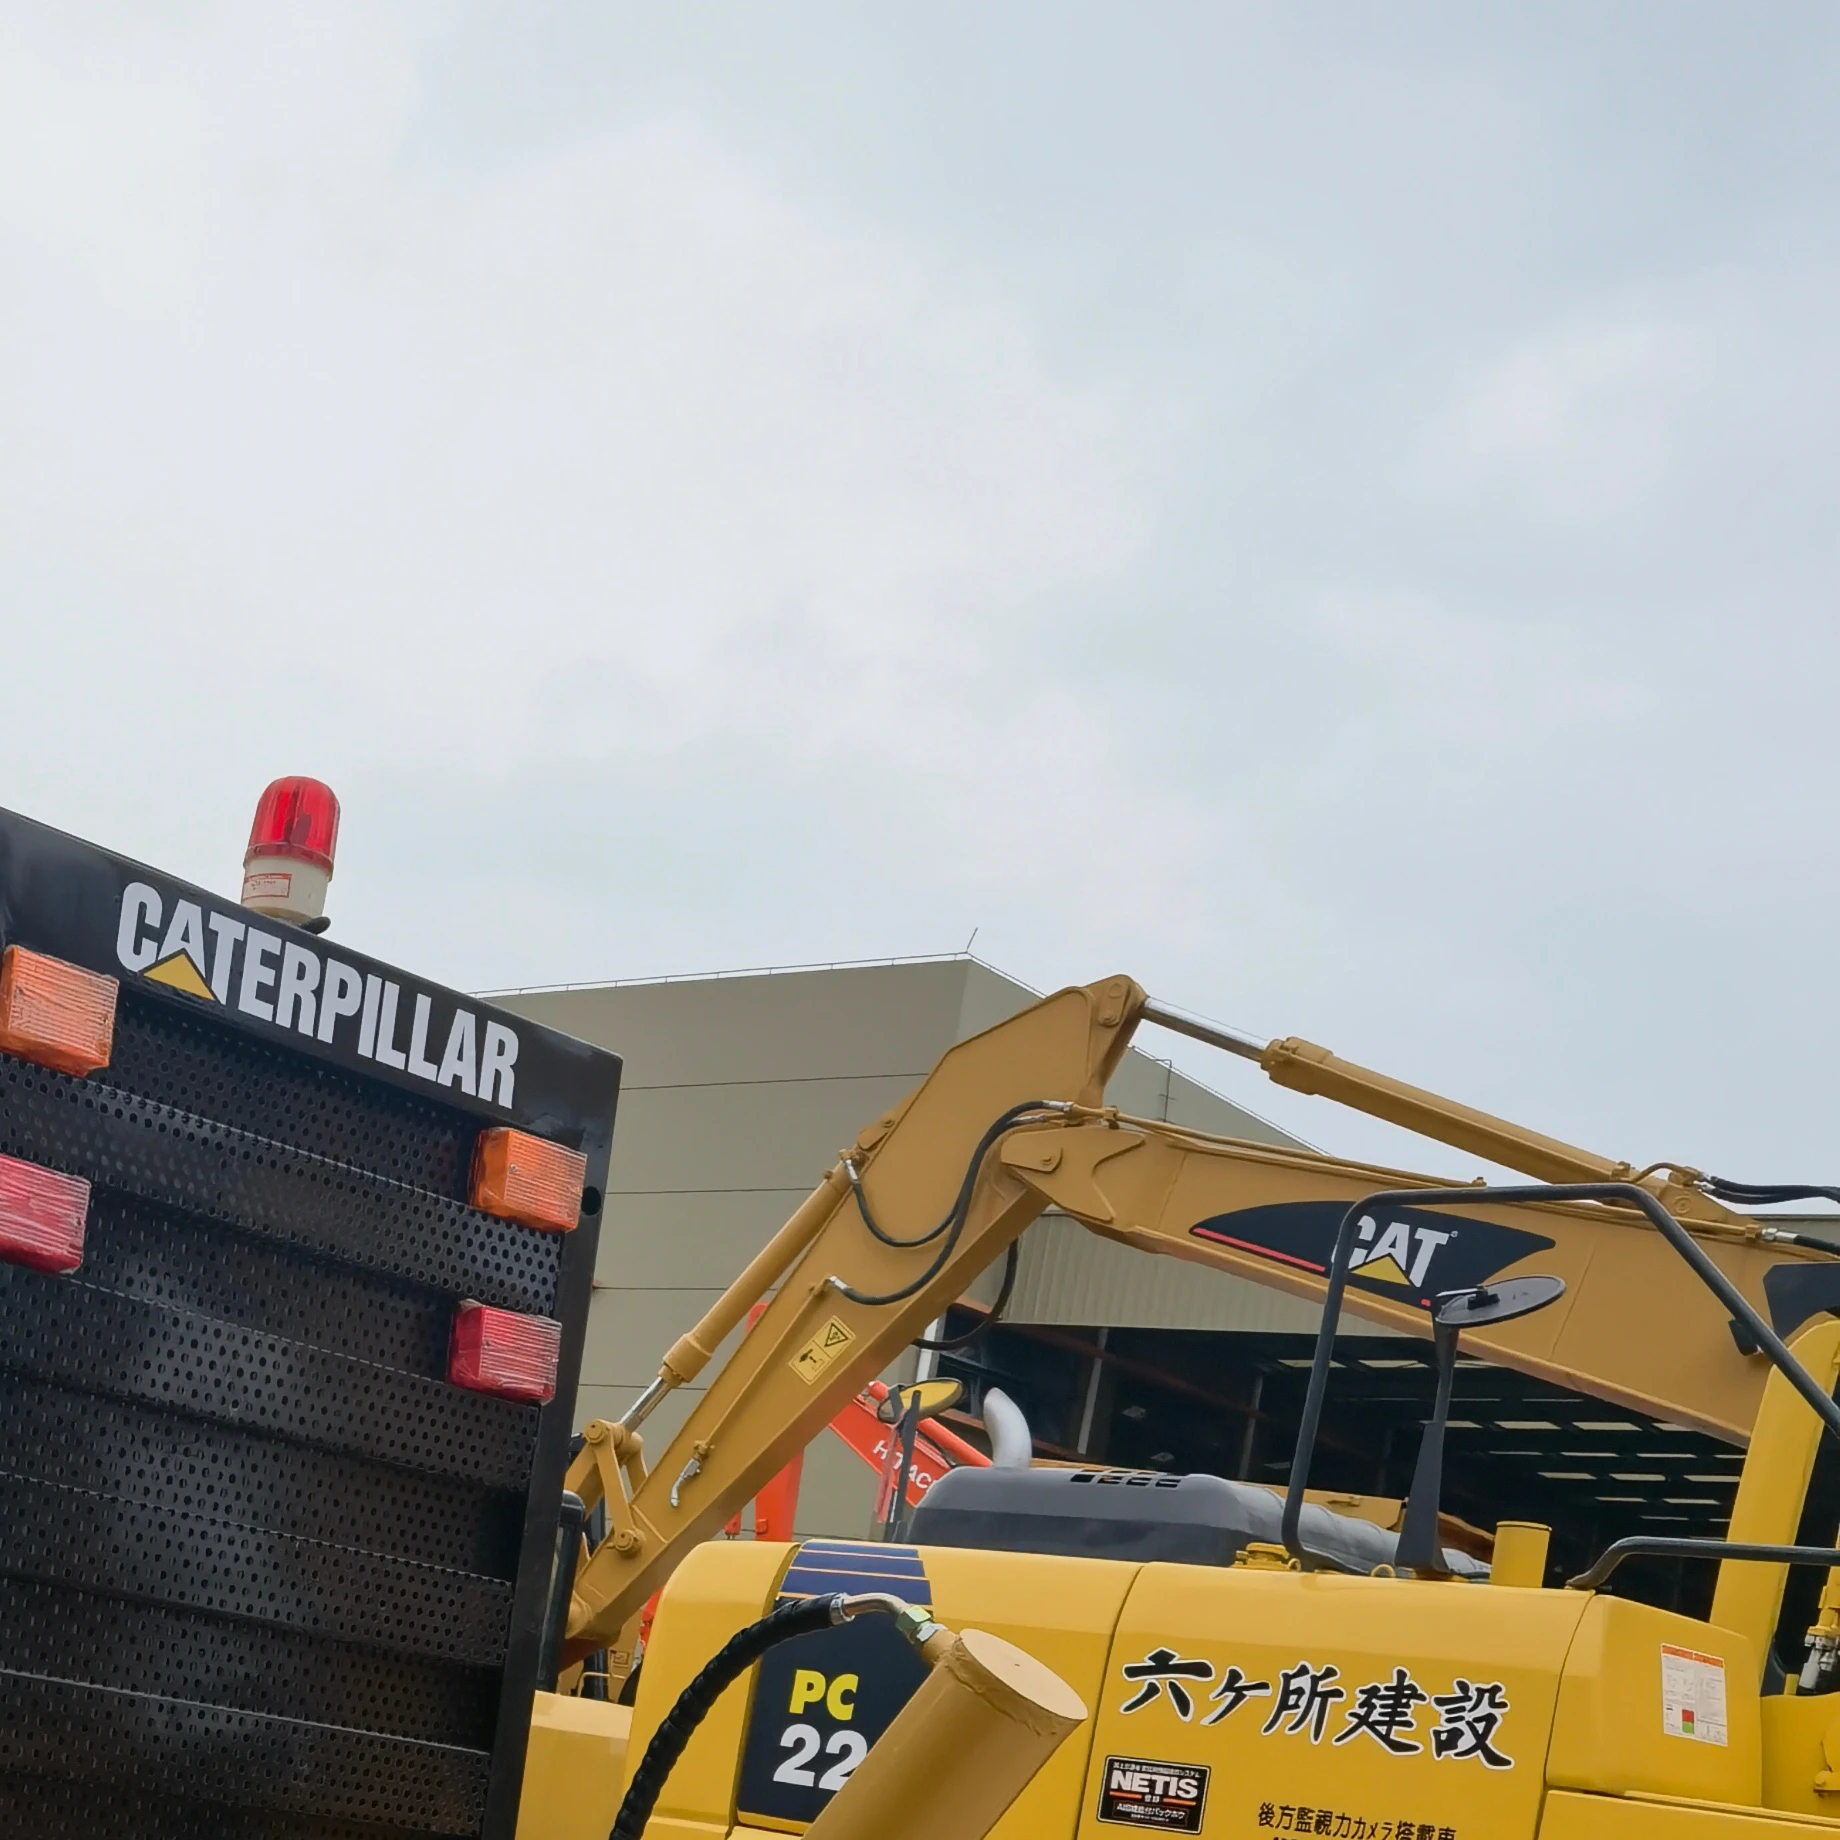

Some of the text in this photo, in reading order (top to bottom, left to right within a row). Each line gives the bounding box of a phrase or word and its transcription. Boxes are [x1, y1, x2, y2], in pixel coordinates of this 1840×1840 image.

[116, 881, 519, 1109] CATERPILLAR
[1331, 1215, 1450, 1288] CAT
[789, 1669, 859, 1721] PC
[1110, 1769, 1198, 1799] NETIS
